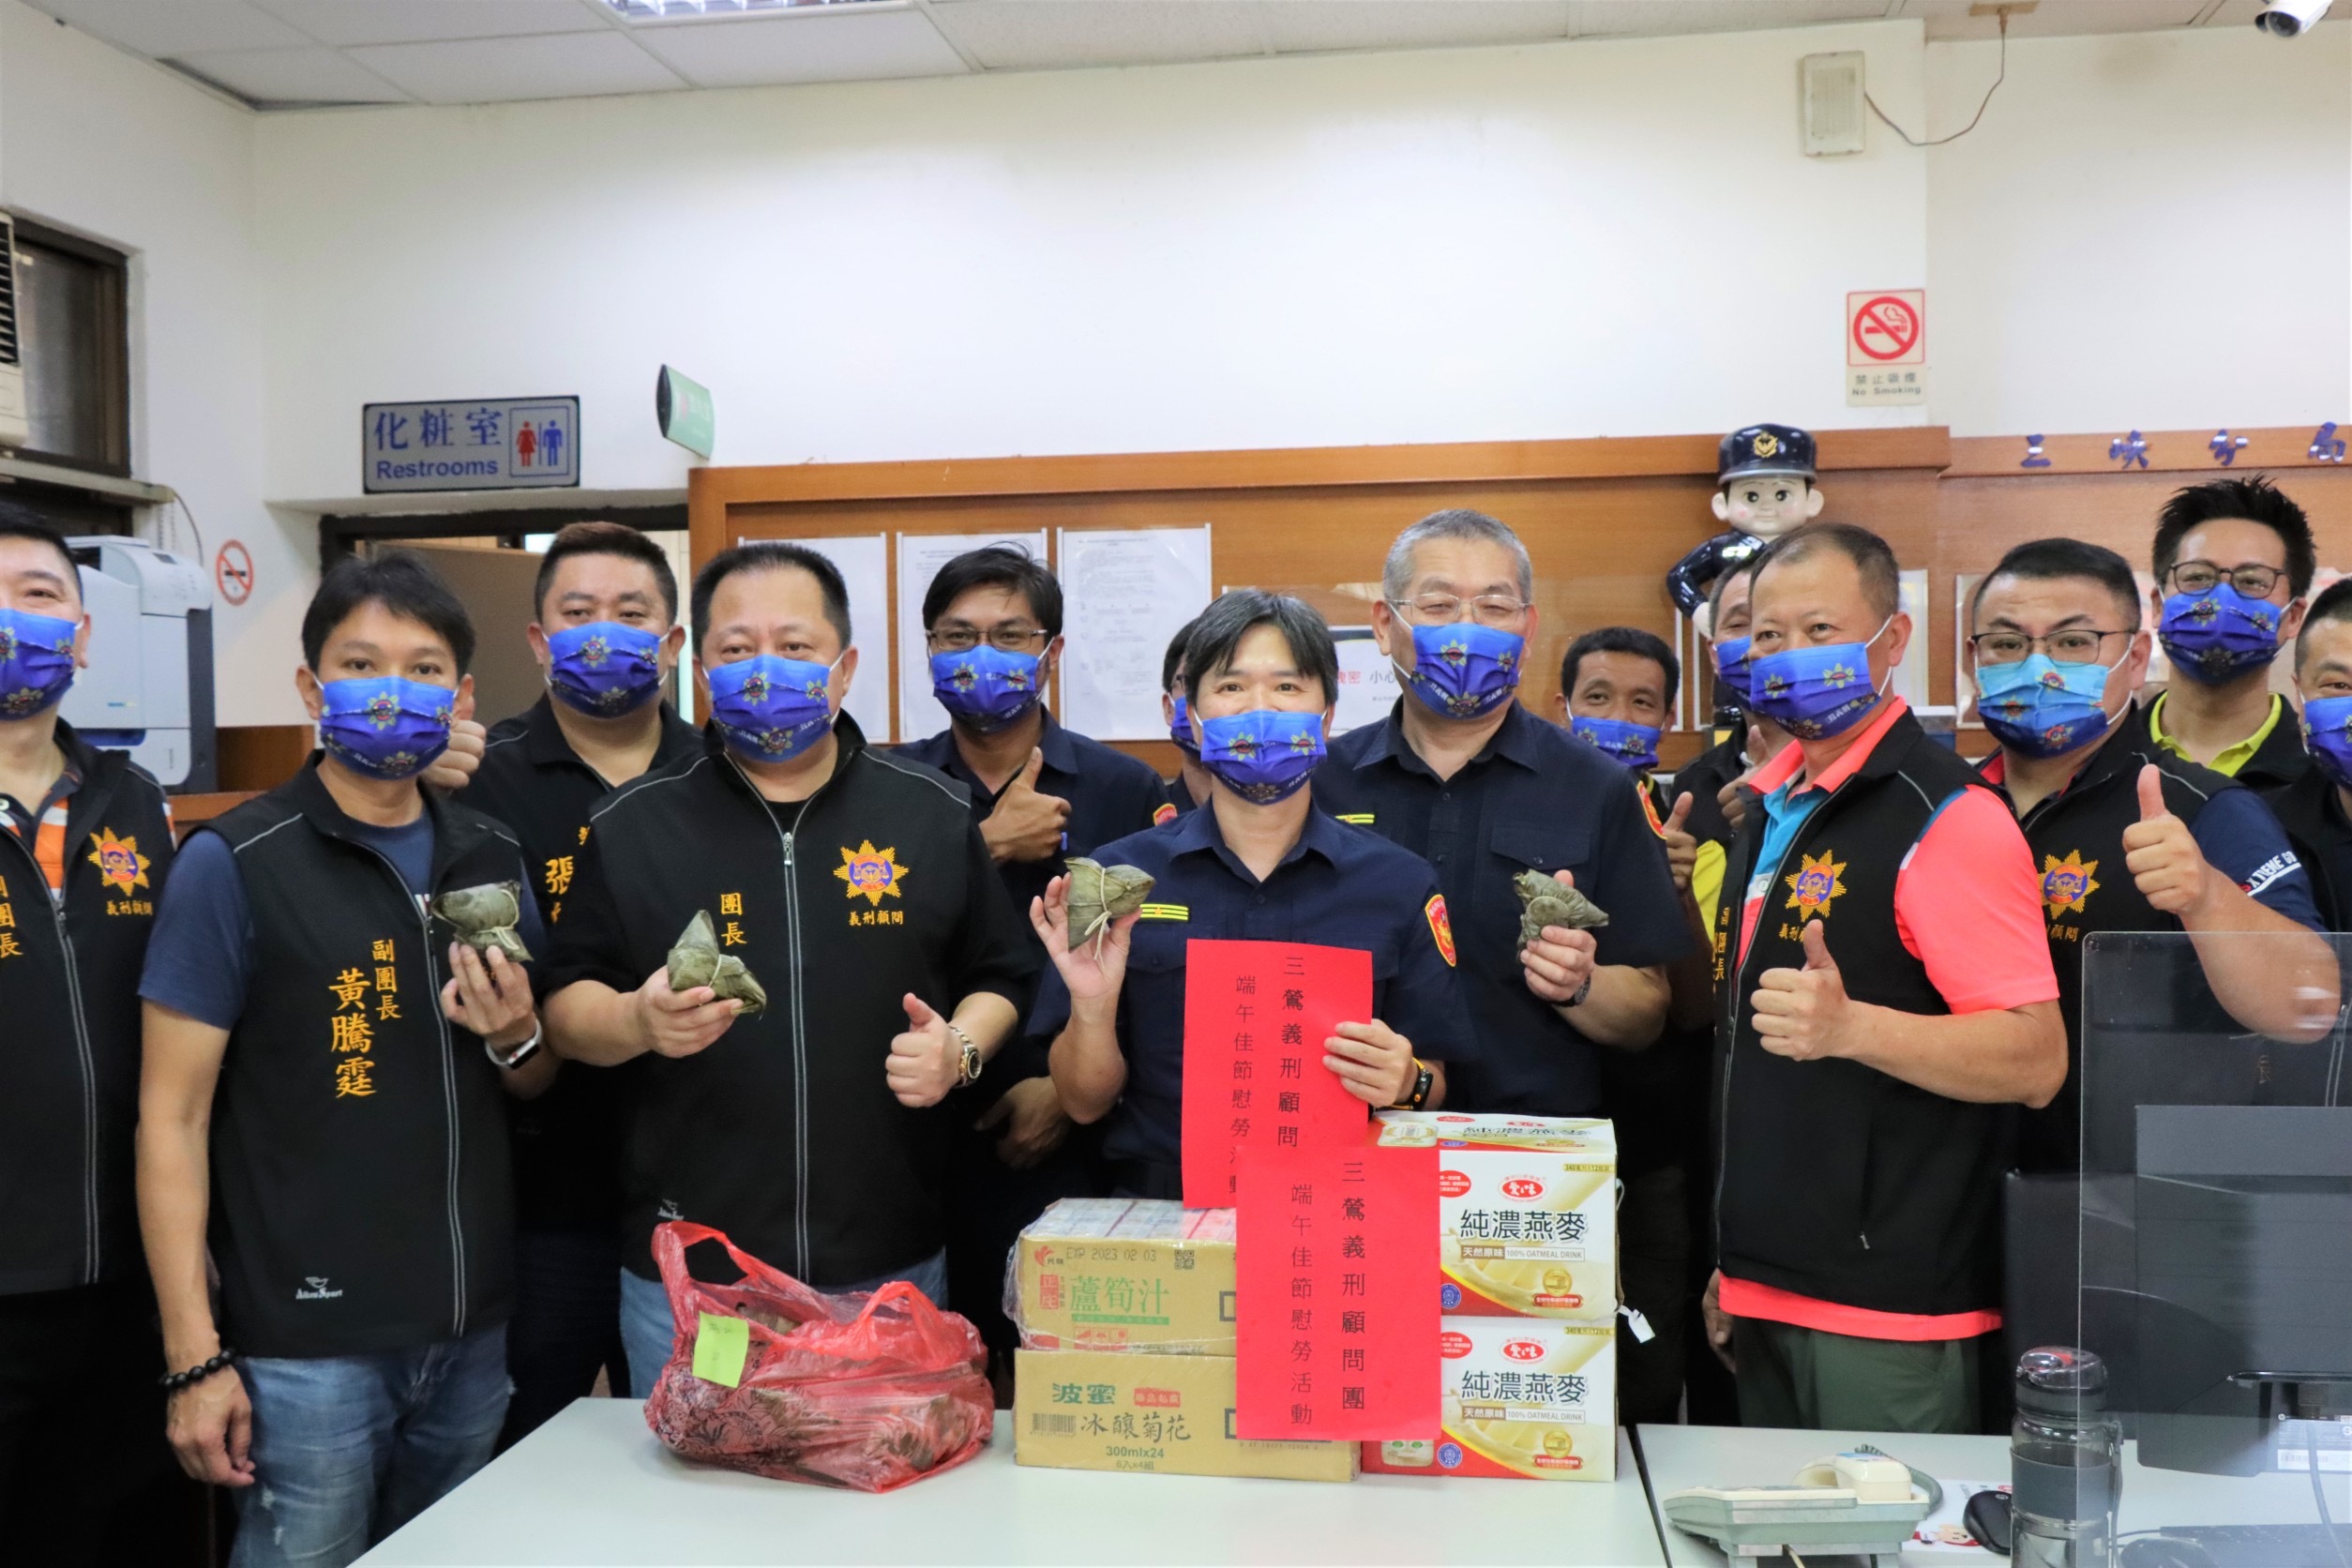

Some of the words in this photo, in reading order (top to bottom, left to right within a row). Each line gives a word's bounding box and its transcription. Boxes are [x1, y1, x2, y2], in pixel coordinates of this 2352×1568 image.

[1874, 386, 1921, 395] Smoking
[373, 407, 503, 450] 化粧室
[377, 460, 498, 479] Restrooms
[0, 875, 23, 958] 團長
[720, 892, 747, 945] 團長
[849, 910, 904, 927] 義刑顧問
[372, 939, 402, 1020] 副團長
[328, 967, 377, 1098] 黃騰霆
[1460, 1209, 1585, 1241] 純濃燕麥
[1066, 1247, 1085, 1259] EXP
[1092, 1248, 1118, 1260] 2023
[1124, 1249, 1137, 1261] 02
[1143, 1249, 1156, 1262] 03
[1463, 1247, 1504, 1259] 天然原味
[1507, 1249, 1525, 1258] 100%
[1527, 1249, 1559, 1259] OATMEAL
[1560, 1250, 1582, 1259] DRINK
[1070, 1274, 1169, 1314] 蘆筍汁
[1341, 1162, 1365, 1410] 三鶯義刑顧問團
[1290, 1183, 1312, 1425] 端午佳節慰勞活動
[1052, 1382, 1116, 1405] 波蜜
[1461, 1370, 1586, 1403] 純濃燕麥
[1081, 1411, 1191, 1442] 冰釀菊花
[1464, 1408, 1504, 1419] 天然原味
[1527, 1411, 1559, 1421] OATMEAL
[1560, 1412, 1582, 1422] DRINK
